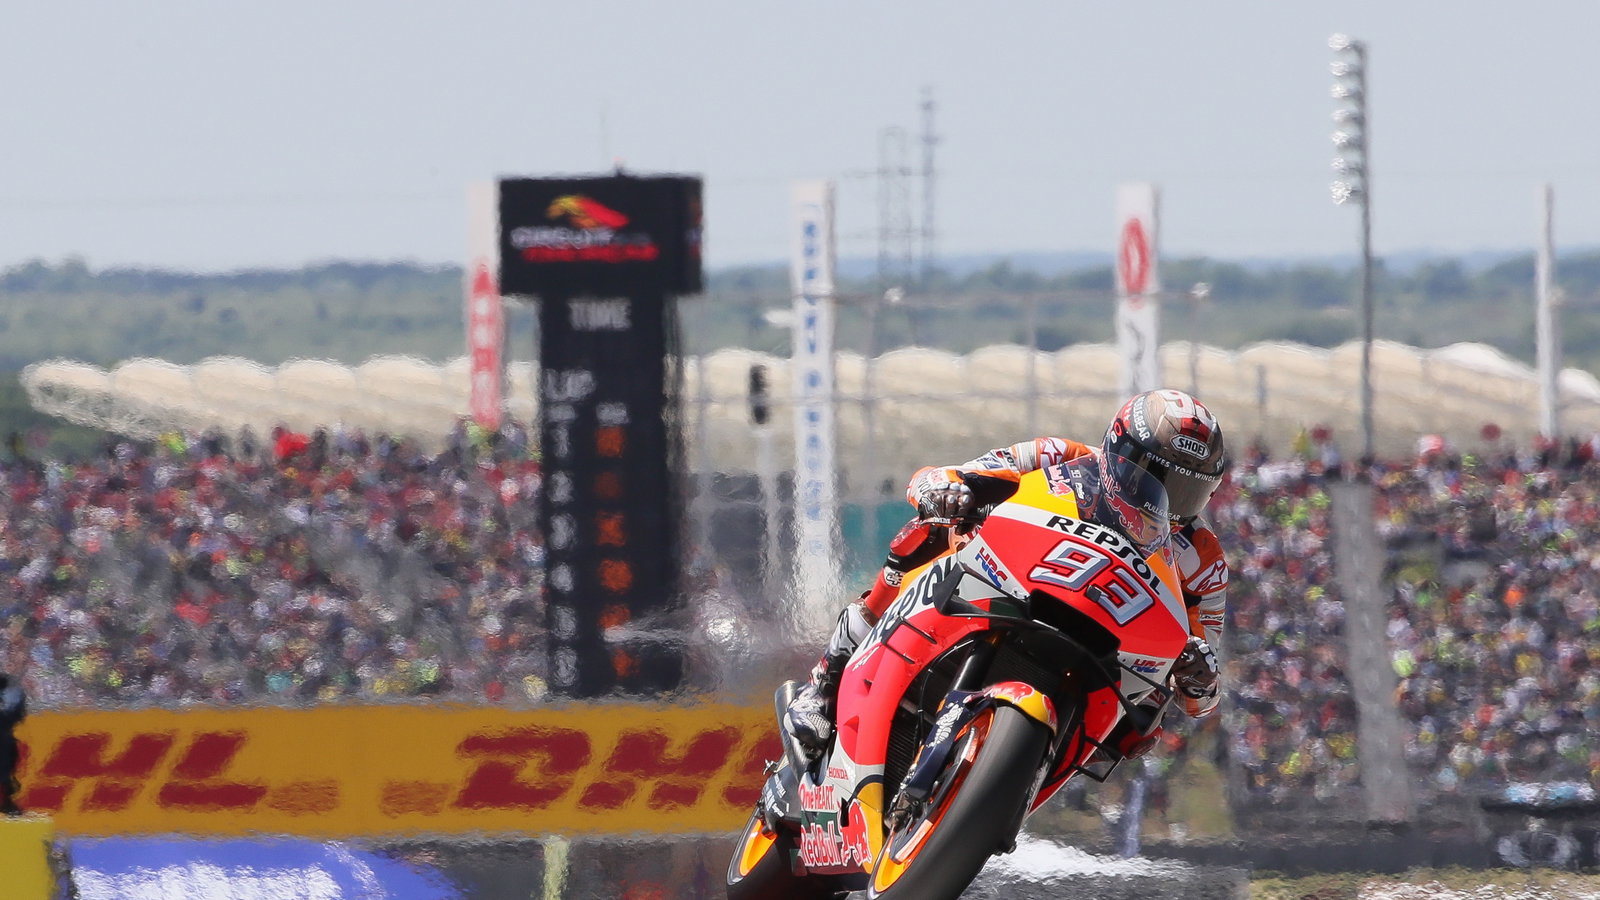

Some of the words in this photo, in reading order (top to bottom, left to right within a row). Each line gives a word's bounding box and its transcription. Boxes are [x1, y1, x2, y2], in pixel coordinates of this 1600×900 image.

[1146, 452, 1171, 468] GIVES
[1174, 465, 1192, 477] YOU
[1177, 438, 1206, 457] SHOEI
[975, 546, 1008, 589] HRC
[1046, 515, 1161, 595] REPSOL
[1026, 539, 1157, 627] 93
[17, 730, 268, 811] HL
[828, 767, 848, 780] HONDA
